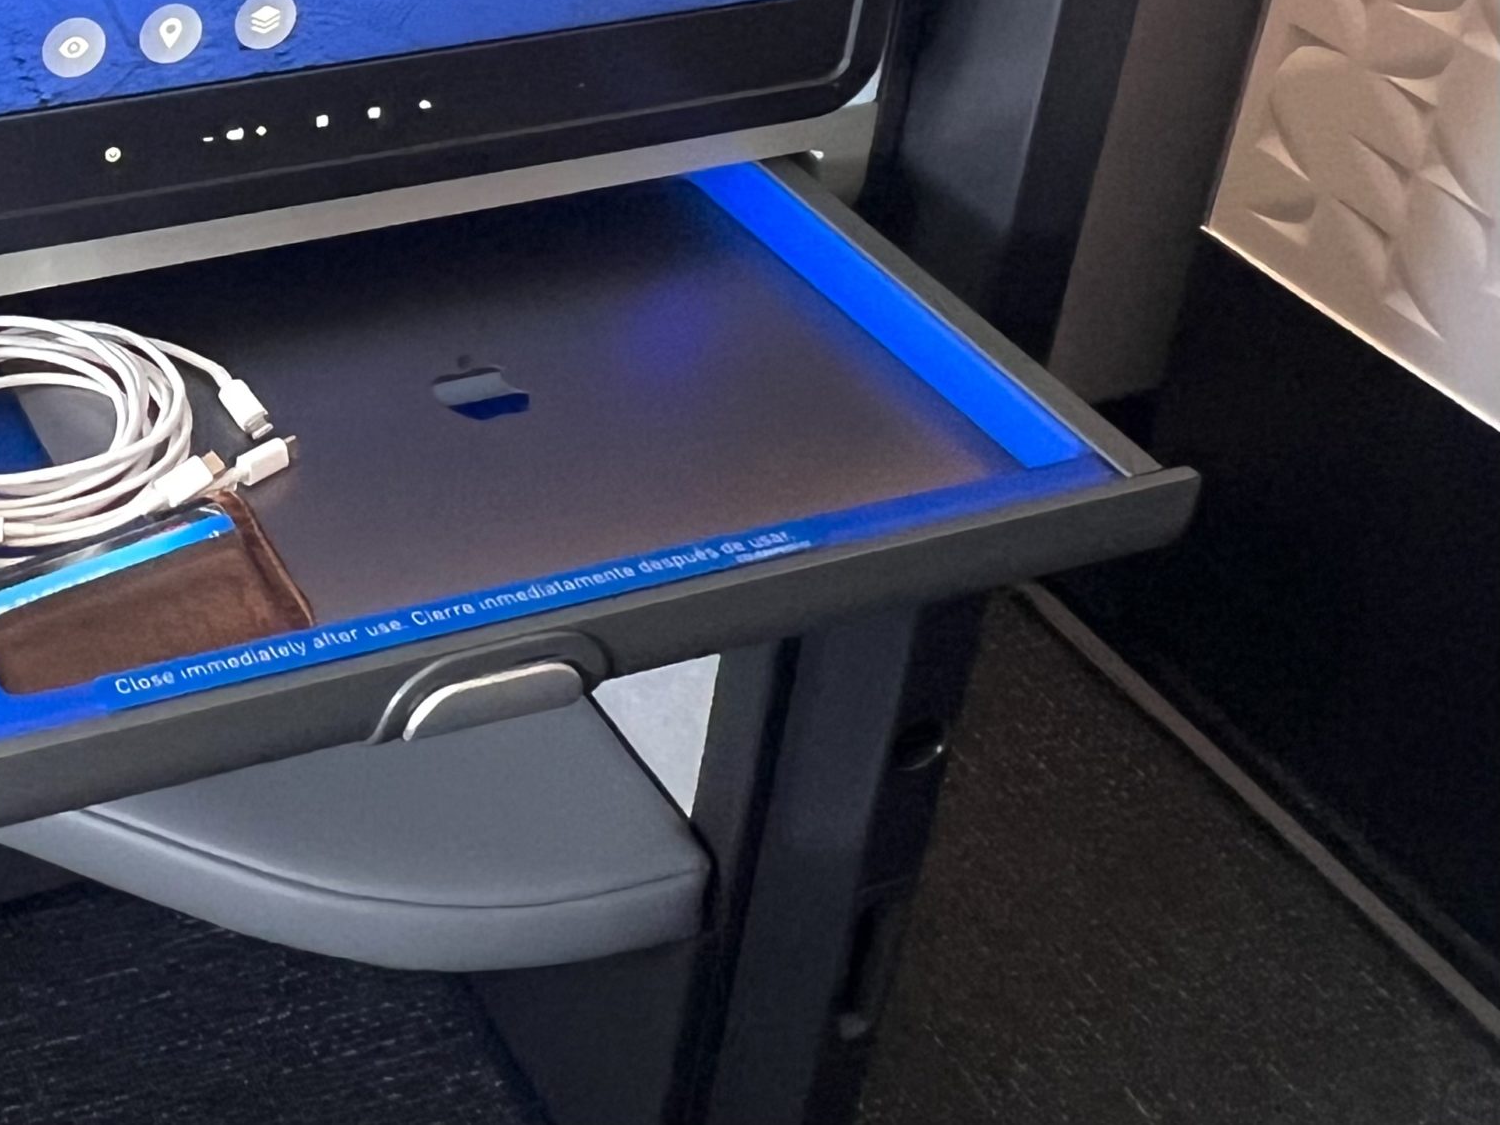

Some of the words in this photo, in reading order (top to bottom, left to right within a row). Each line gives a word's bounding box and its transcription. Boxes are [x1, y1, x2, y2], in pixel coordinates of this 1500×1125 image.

[114, 670, 176, 694] Close
[181, 641, 308, 680] immediately
[313, 626, 359, 650] after
[411, 603, 476, 628] Cierre
[479, 565, 638, 612] inmediatamente
[720, 541, 746, 555] de
